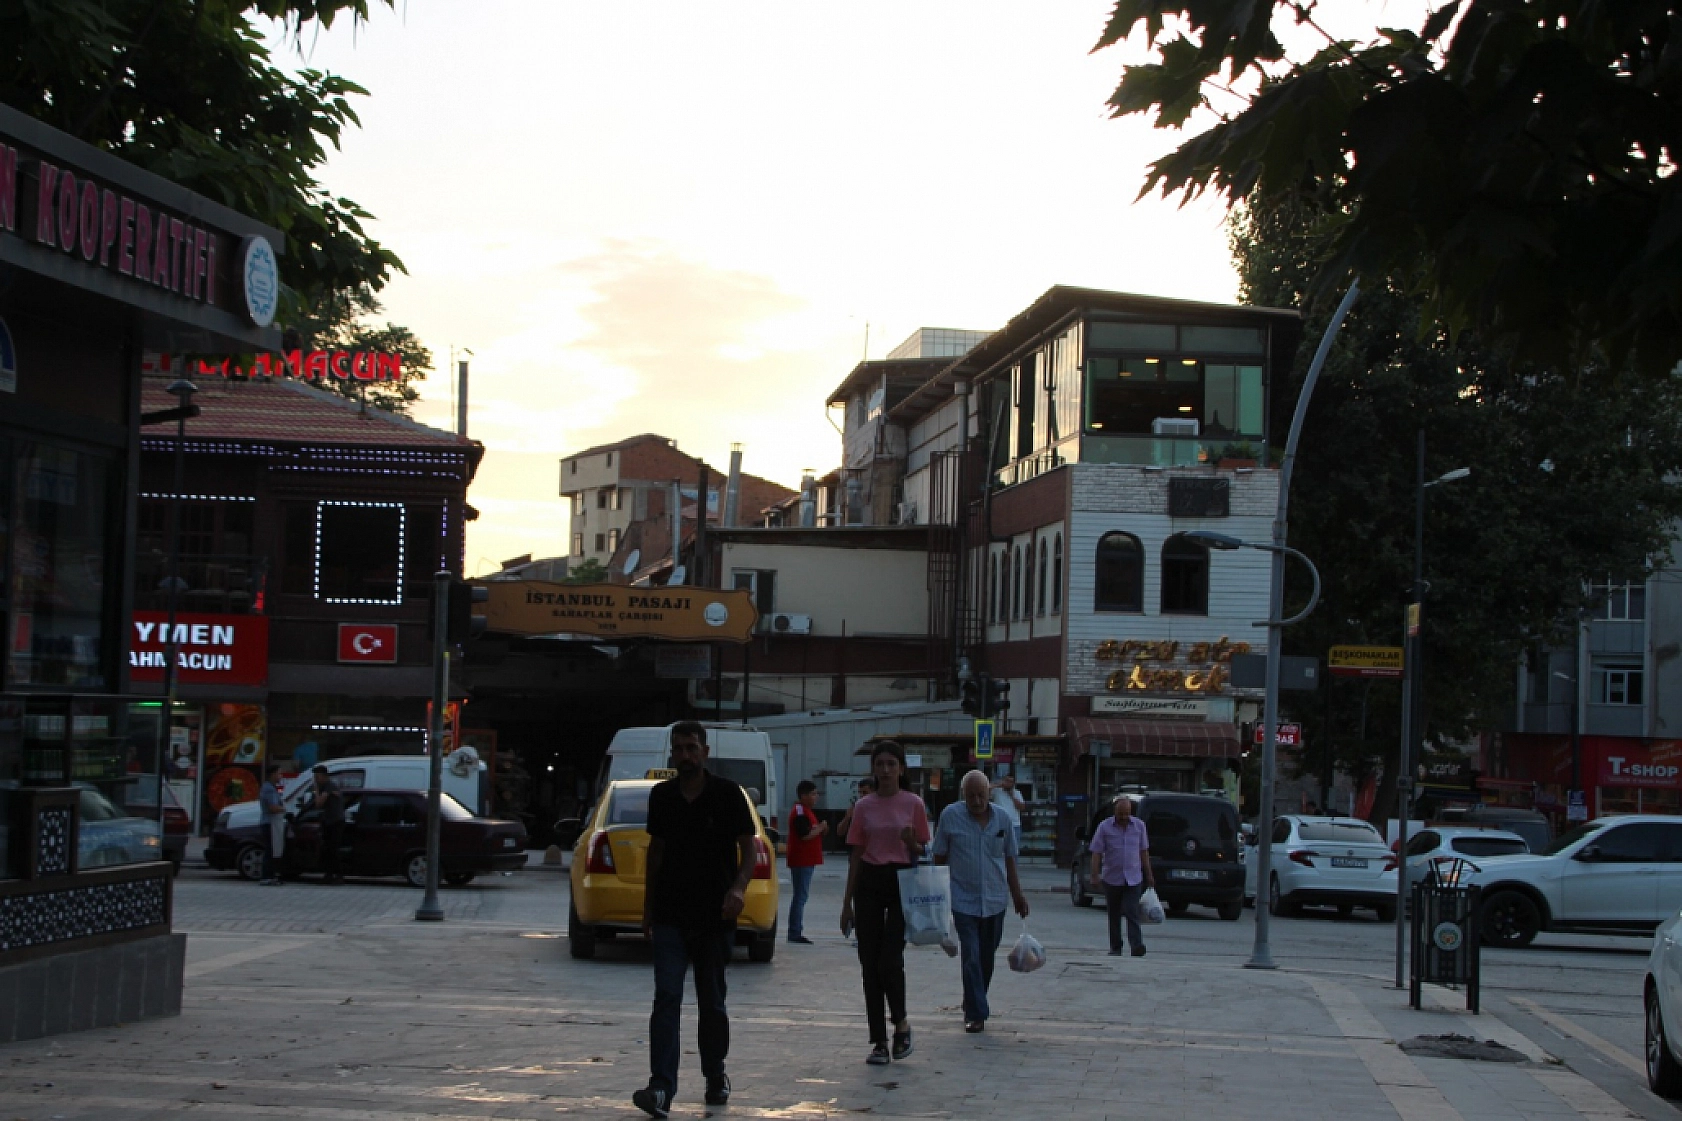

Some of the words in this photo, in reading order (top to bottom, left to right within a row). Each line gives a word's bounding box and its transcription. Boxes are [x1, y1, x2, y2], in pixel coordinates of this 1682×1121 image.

[37, 159, 216, 305] KOOPERATİFİ
[526, 591, 615, 607] İSTANBUL
[628, 596, 691, 610] PASAJI
[1107, 664, 1229, 693] ekmek
[1607, 756, 1680, 777] T-SHOP
